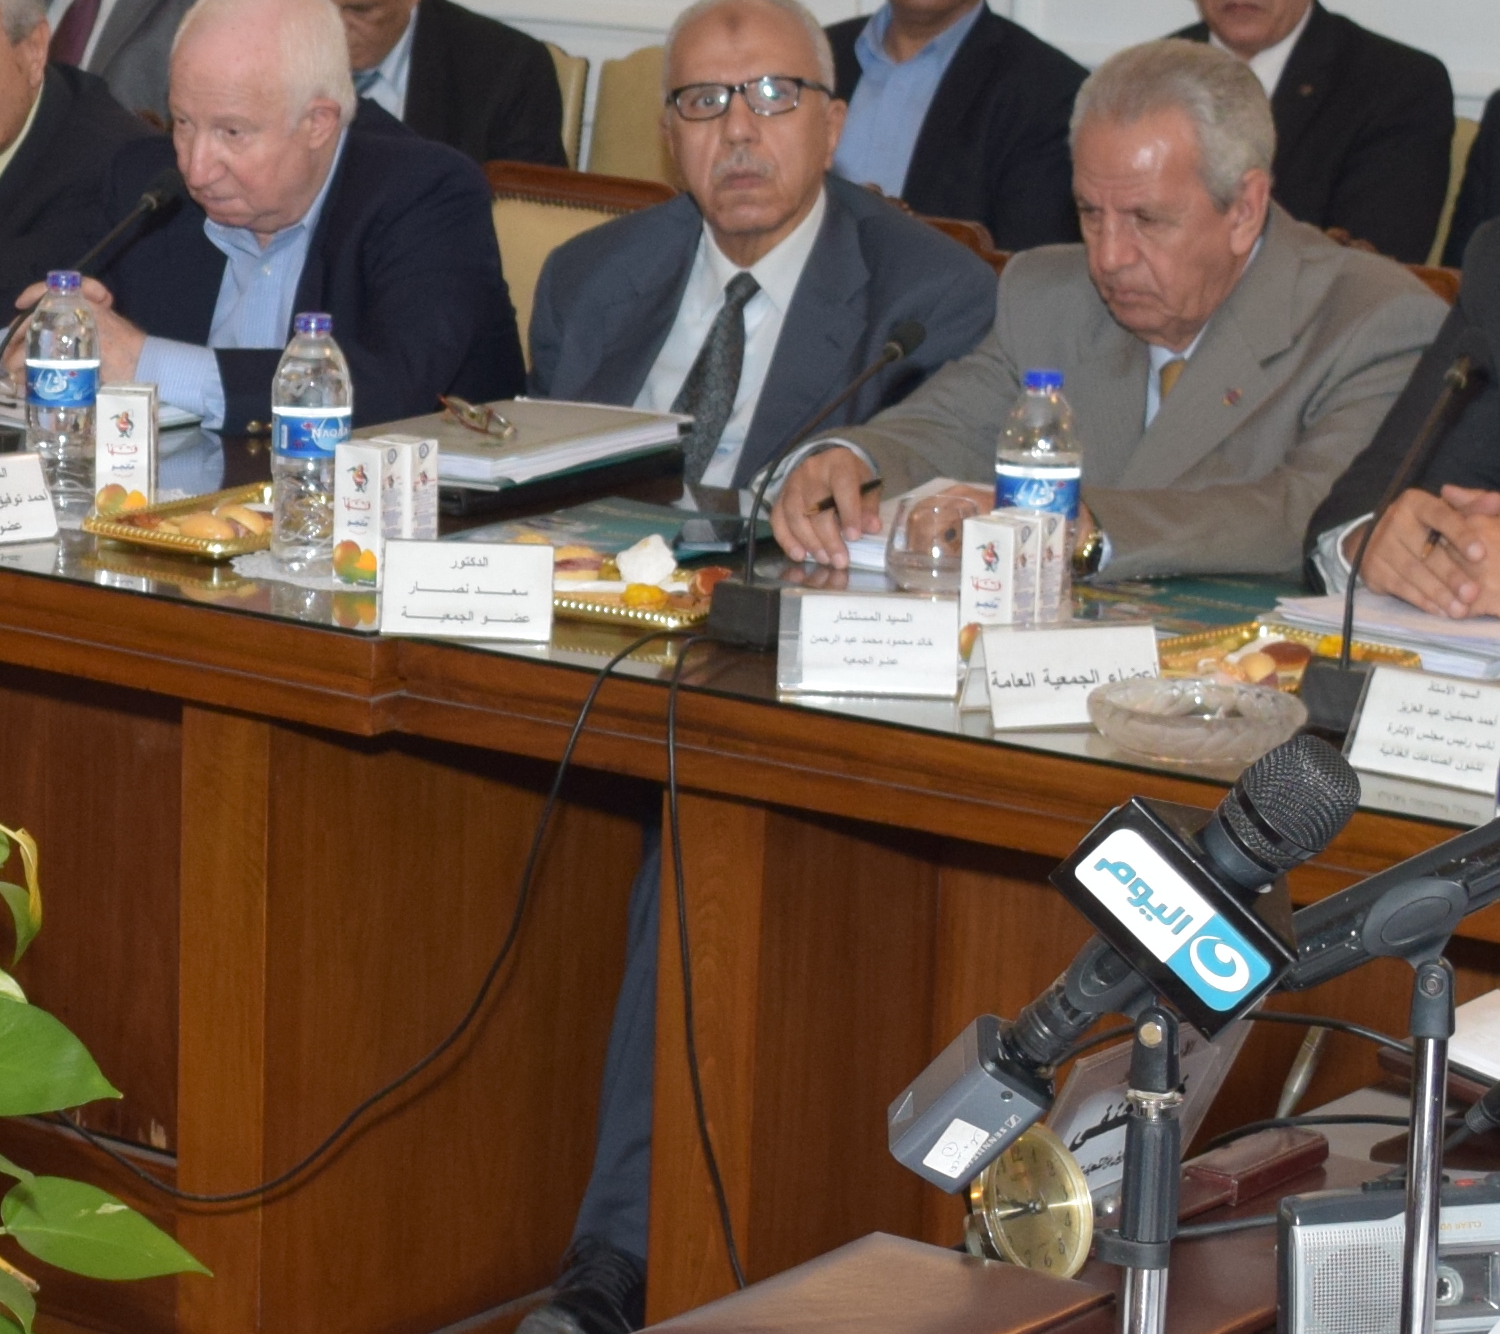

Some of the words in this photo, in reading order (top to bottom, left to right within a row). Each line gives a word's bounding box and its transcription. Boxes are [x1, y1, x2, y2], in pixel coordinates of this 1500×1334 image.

[27, 489, 49, 503] أحمد
[450, 556, 489, 571] الدكتور
[408, 580, 470, 595] نصار
[474, 583, 529, 596] سعد
[401, 605, 474, 624] الجمعية
[481, 611, 531, 624] عضو
[833, 610, 882, 624] المستشار
[886, 612, 914, 626] السيد
[809, 634, 841, 645] الرحمن
[861, 636, 884, 645] محمد
[886, 637, 914, 647] محمود
[916, 637, 934, 647] خالد
[878, 657, 899, 667] عضو
[991, 671, 1037, 690] العامة
[1043, 668, 1101, 691] الجمعية
[1459, 688, 1481, 700] السيد
[1397, 701, 1424, 714] العزيز
[1477, 715, 1498, 727] أحمد
[1416, 730, 1445, 743] مجلس
[1446, 735, 1472, 748] رئيس
[1093, 857, 1194, 936] اليوم
